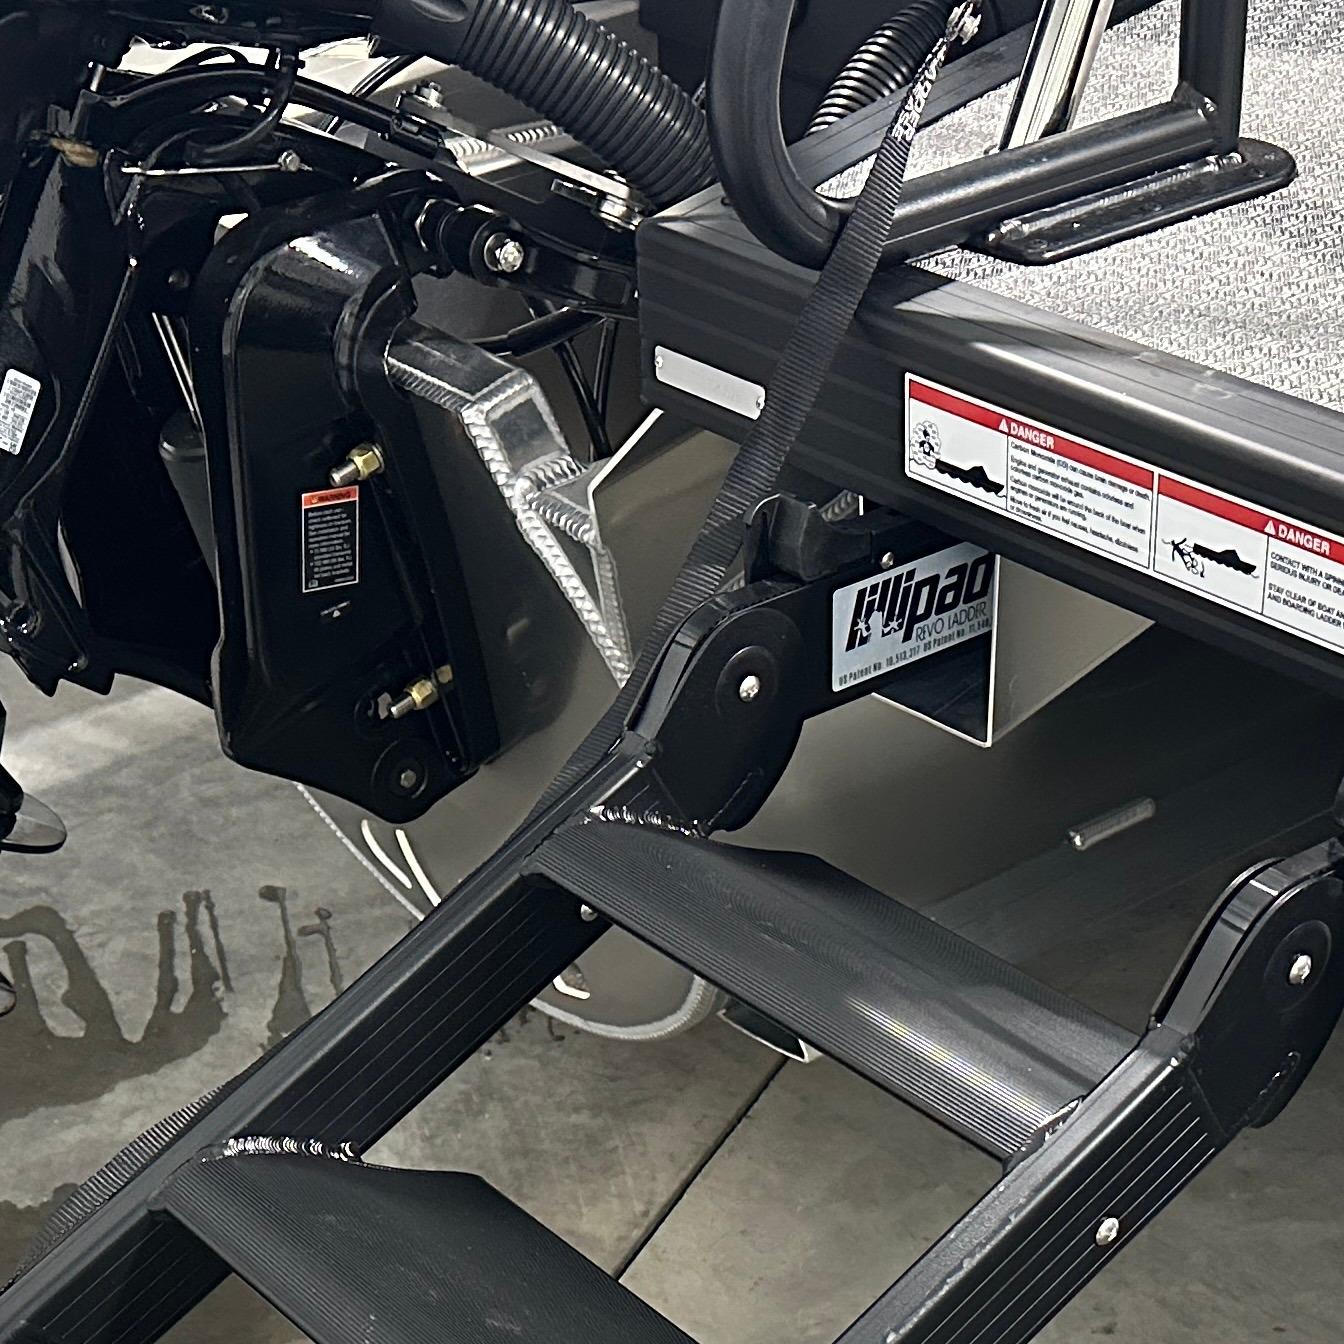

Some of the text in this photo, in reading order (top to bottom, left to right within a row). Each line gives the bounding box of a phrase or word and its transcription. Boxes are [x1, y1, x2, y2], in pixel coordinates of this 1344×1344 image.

[1010, 422, 1055, 450] DANGER
[1027, 462, 1036, 471] and
[1278, 523, 1331, 556] DANGER
[1270, 550, 1299, 569] CONTACT
[1301, 562, 1317, 575] WITH
[1318, 569, 1322, 577] A
[1270, 560, 1297, 578] SERIOUS
[1298, 572, 1321, 587] INJURY
[1322, 581, 1331, 591] OR
[1267, 591, 1281, 603] AND
[1282, 597, 1315, 617] BOARDING
[1316, 611, 1341, 628] LADDER
[1268, 582, 1283, 595] STAY
[1285, 589, 1306, 604] CLEAR
[1307, 598, 1316, 608] OF
[1317, 602, 1334, 615] BOAT
[915, 601, 987, 643] REVO LADDER
[849, 664, 871, 682] Patent
[923, 640, 931, 651] US
[933, 631, 954, 648] Patent
